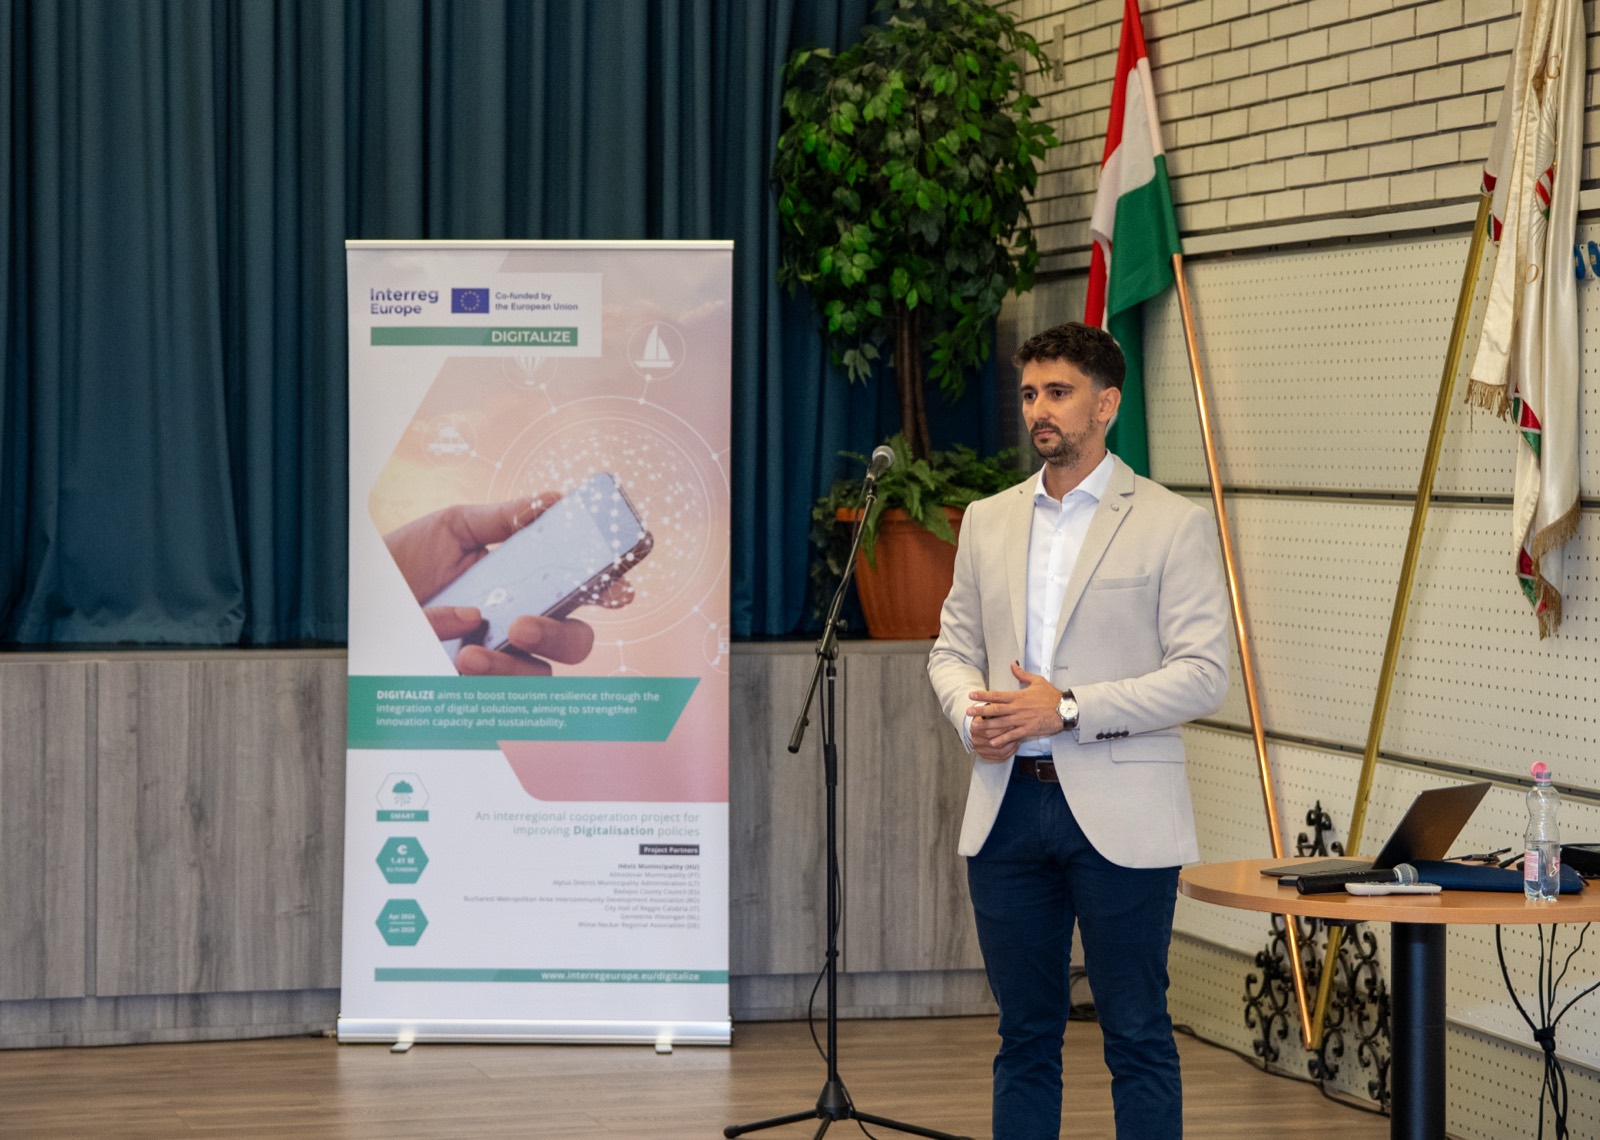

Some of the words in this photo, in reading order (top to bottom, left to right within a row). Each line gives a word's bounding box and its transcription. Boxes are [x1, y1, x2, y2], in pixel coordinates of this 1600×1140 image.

[371, 288, 439, 303] Interreg
[495, 292, 539, 300] Co-funded
[541, 292, 552, 302] by
[371, 304, 422, 316] Europe
[495, 303, 508, 311] the
[511, 303, 550, 312] European
[553, 303, 578, 311] Union
[492, 331, 571, 342] DIGITALIZE
[377, 691, 435, 699] DIGITALIZE
[438, 691, 461, 700] aims
[464, 692, 474, 700] to
[477, 691, 505, 700] boost
[508, 691, 547, 700] tourism
[550, 692, 598, 700] resilience
[601, 692, 641, 703] through
[643, 692, 660, 701] the
[377, 704, 432, 715] integration
[434, 704, 445, 713] of
[448, 704, 478, 715] digital
[481, 704, 529, 714] solutions,
[532, 705, 566, 716] aiming
[569, 706, 579, 714] to
[582, 705, 637, 716] strengthen
[377, 717, 430, 726] innovation
[432, 718, 473, 728] capacity
[476, 718, 495, 726] and
[498, 718, 566, 729] sustainability.
[390, 812, 415, 820] SMART
[475, 811, 490, 821] An
[493, 811, 566, 823] interregional
[569, 812, 637, 824] cooperation
[641, 812, 680, 824] project
[683, 812, 700, 822] for
[513, 825, 570, 837] improving
[573, 825, 654, 837] Digitalisation
[658, 825, 700, 838] policies
[644, 846, 667, 854] Project
[541, 971, 700, 982] www.interregeurope.eu/digitalize
